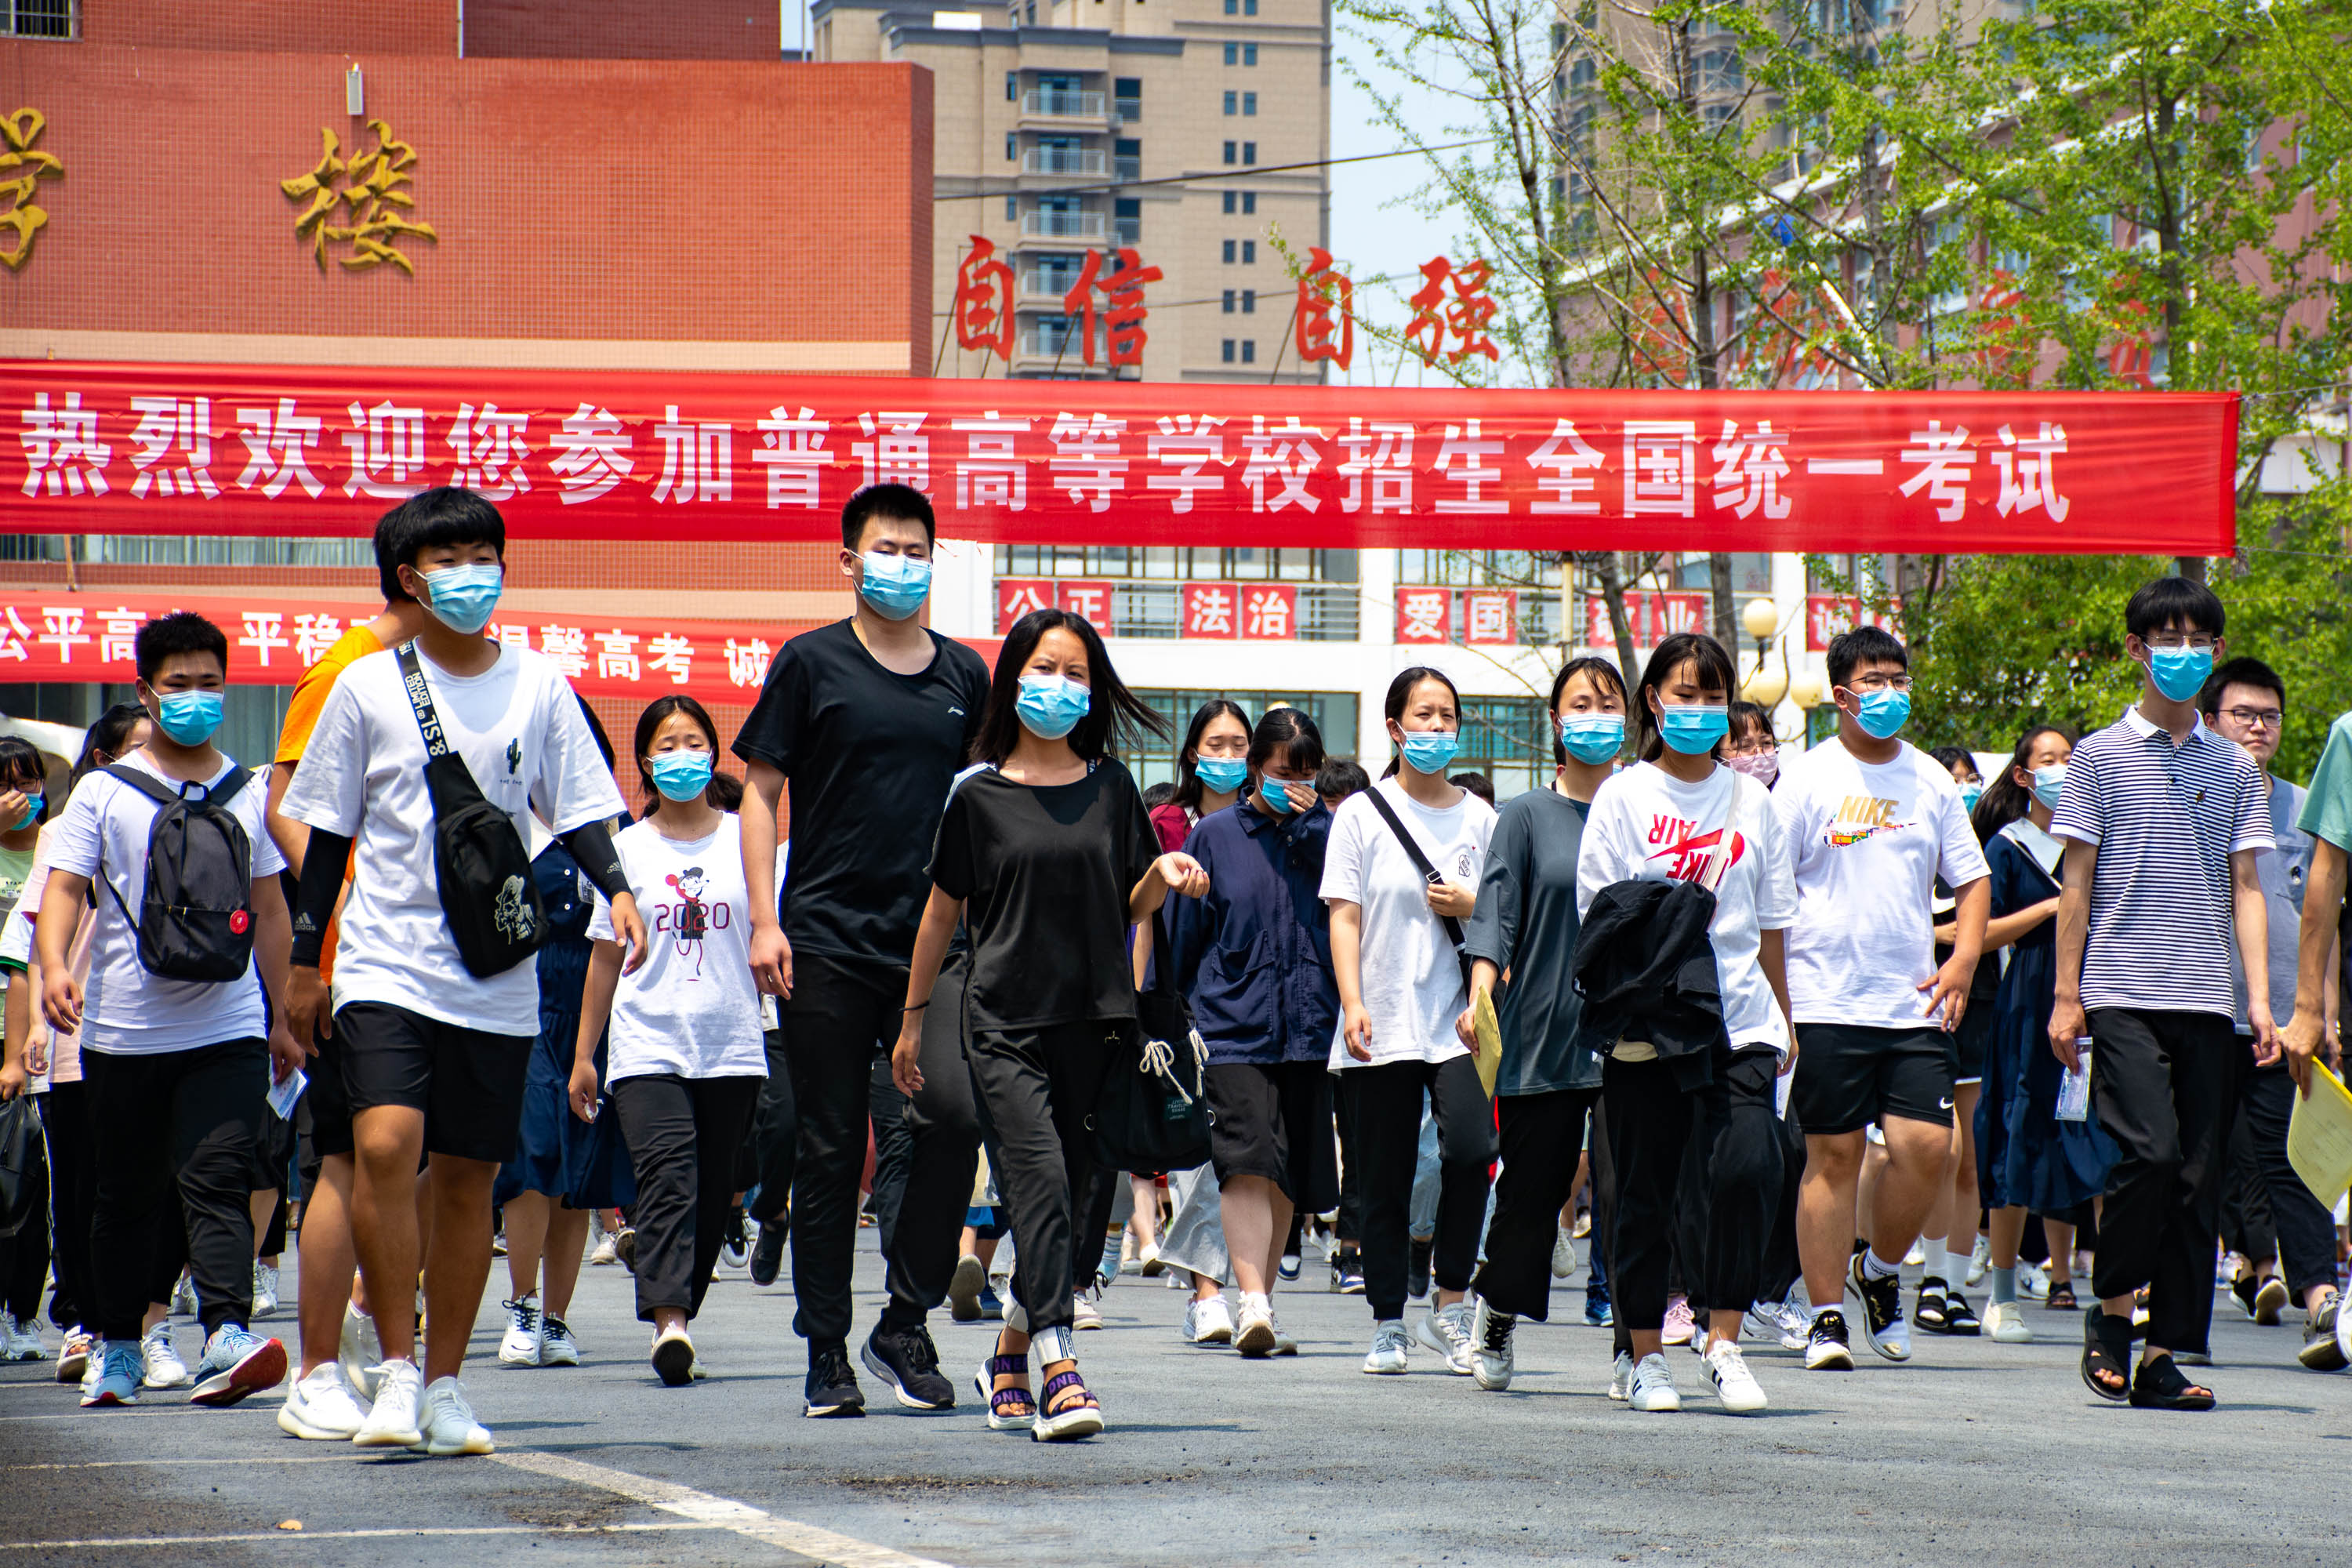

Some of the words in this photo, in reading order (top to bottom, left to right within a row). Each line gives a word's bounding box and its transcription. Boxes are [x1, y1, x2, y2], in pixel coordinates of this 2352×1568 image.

[956, 234, 1163, 367] 自信
[1295, 247, 1499, 370] 自强
[20, 391, 2071, 523] 热烈欢迎您参加普通高等学校招生全国统一考试
[1190, 589, 1290, 636] 法治
[1403, 593, 1508, 641] 爱国
[0, 607, 183, 663] 公平高
[405, 675, 423, 710] LIMITED
[412, 671, 431, 707] EDITION
[1648, 814, 1697, 844] AIR
[1838, 796, 1900, 826] NIKE
[1665, 850, 1730, 887] IKE
[655, 902, 730, 932] 2020
